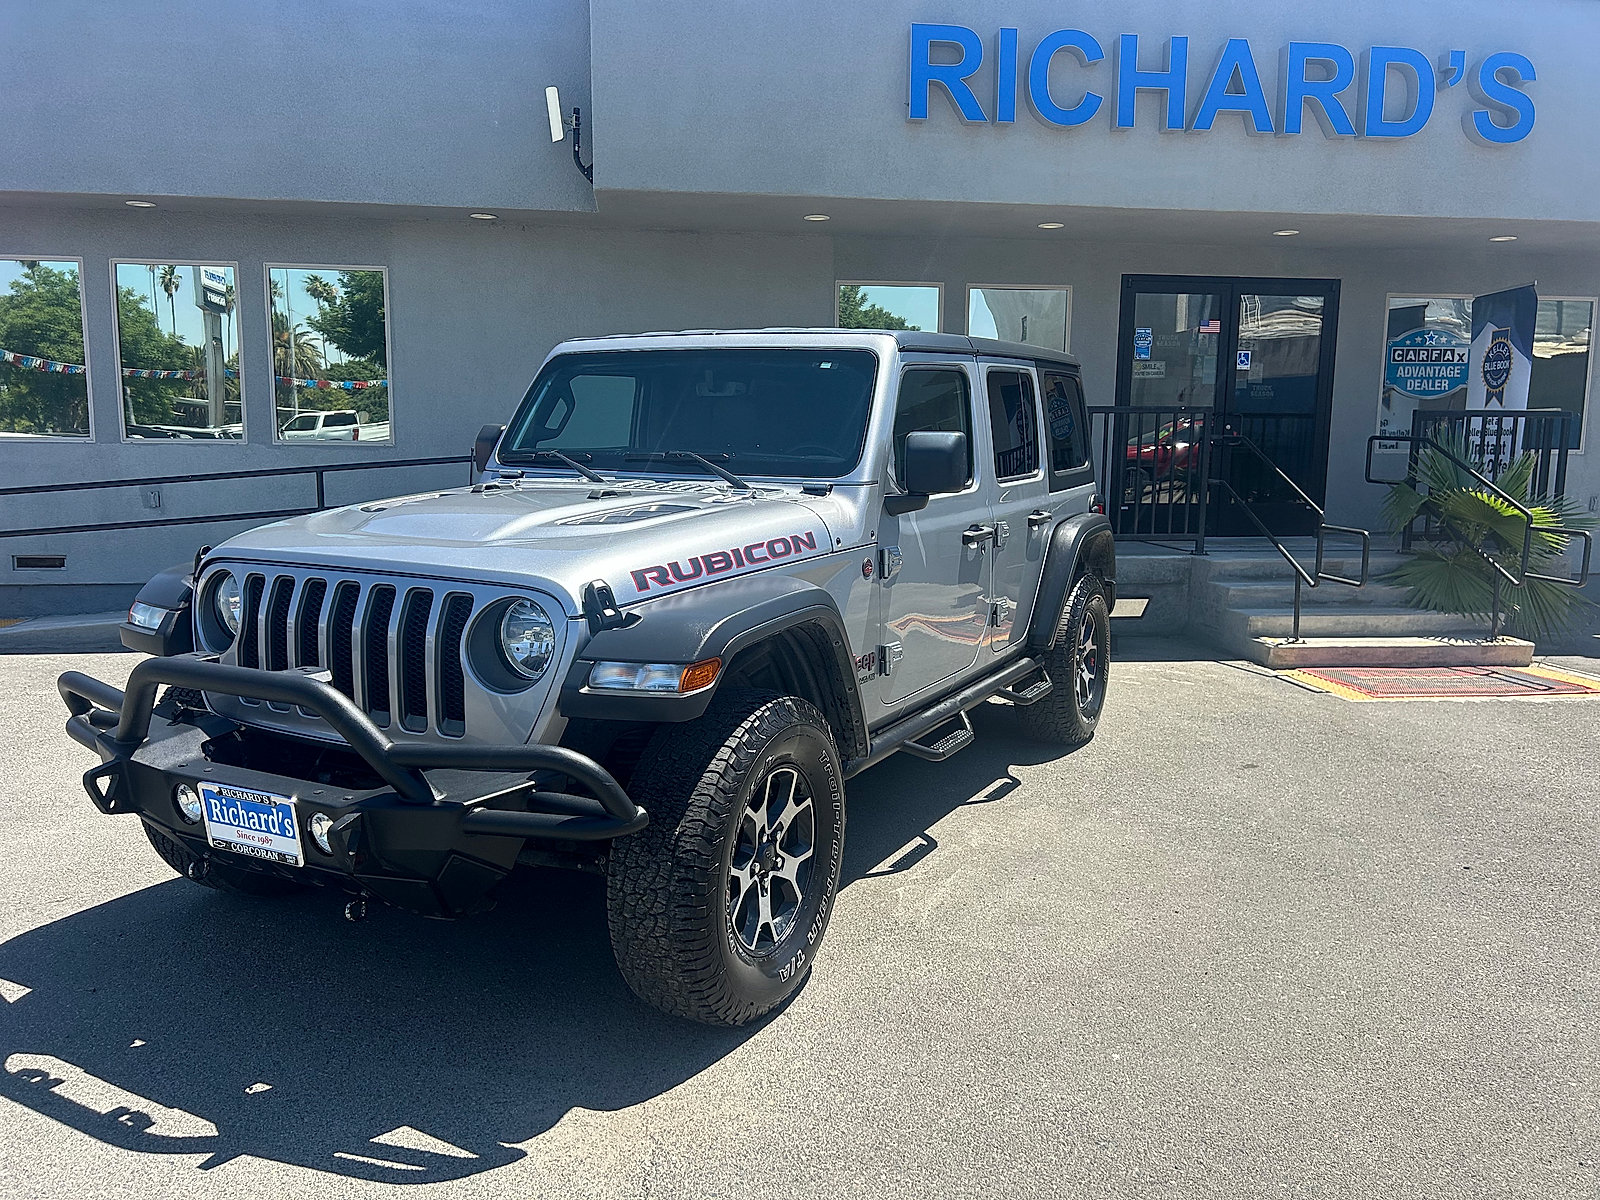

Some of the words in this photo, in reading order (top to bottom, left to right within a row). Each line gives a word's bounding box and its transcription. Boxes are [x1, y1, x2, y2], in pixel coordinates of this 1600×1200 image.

[907, 22, 1537, 144] RICHARD'S
[1393, 350, 1467, 362] CARFAX
[1488, 344, 1510, 358] KELLEY
[1396, 365, 1461, 378] ADVANTAGE
[1484, 361, 1496, 371] BLUE
[1497, 360, 1510, 370] BOOK
[1406, 379, 1449, 391] DEALER
[1472, 440, 1507, 455] Intat
[630, 531, 817, 592] RUBICON
[853, 651, 876, 672] eep
[220, 787, 269, 804] RICHARD'S
[208, 798, 294, 837] Richard's
[236, 829, 256, 842] Since
[257, 836, 273, 846] 1987
[231, 842, 279, 861] CORCORAN
[779, 949, 806, 983] T/A
